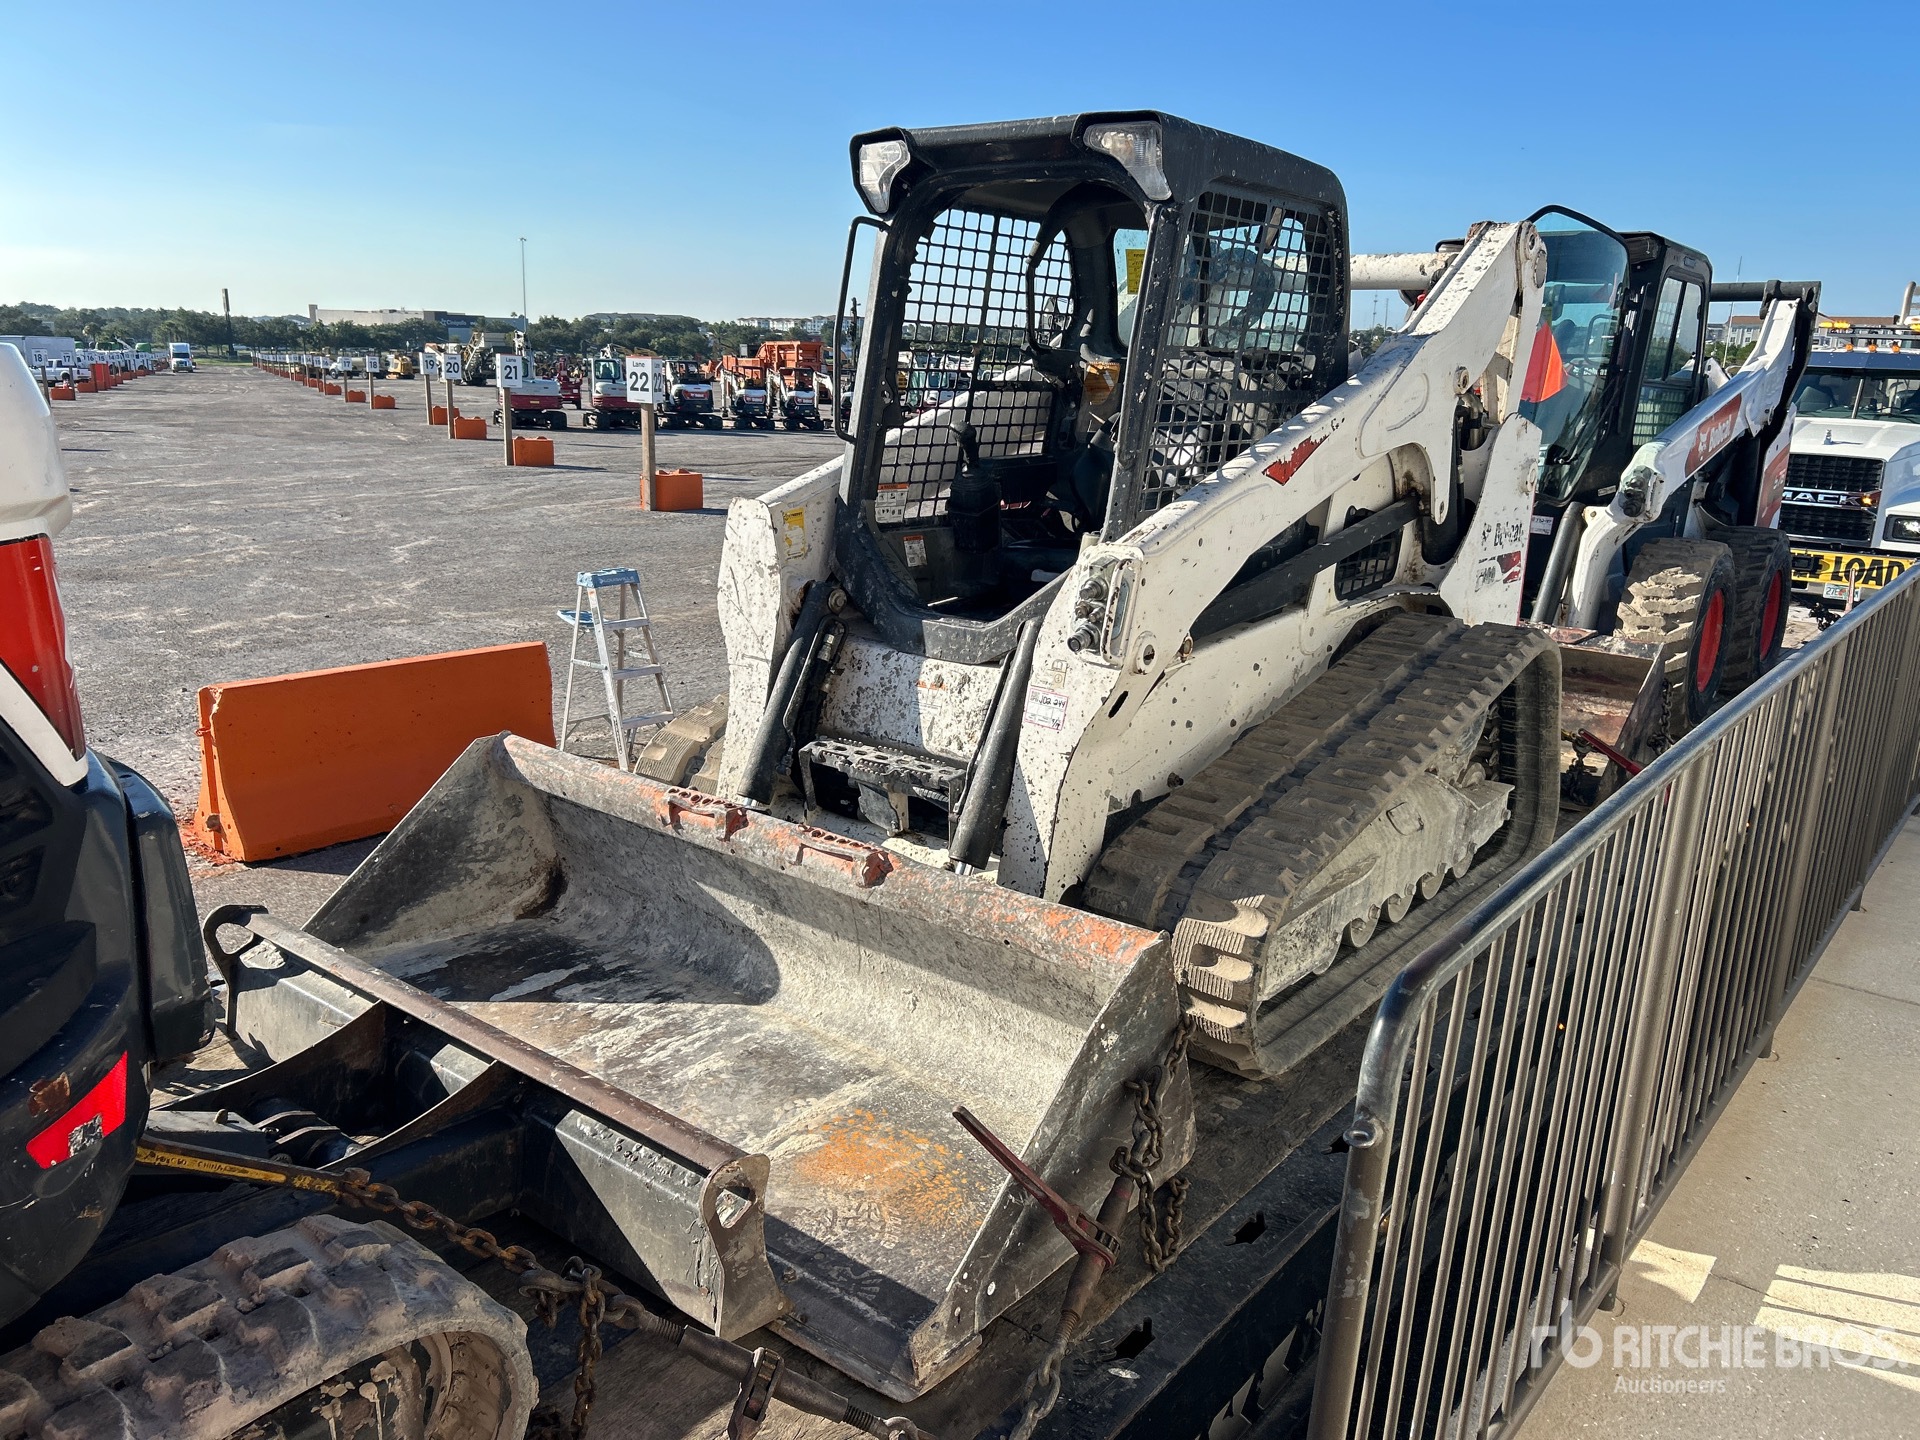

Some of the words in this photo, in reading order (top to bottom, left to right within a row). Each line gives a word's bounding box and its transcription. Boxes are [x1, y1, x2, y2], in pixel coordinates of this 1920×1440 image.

[34, 354, 42, 362] 18
[369, 361, 377, 369] 18
[425, 360, 435, 370] 19
[445, 362, 459, 373] 20
[504, 365, 517, 379] 21
[629, 371, 649, 392] 22
[653, 372, 662, 392] 22
[1709, 414, 1732, 452] Bobcat
[1831, 556, 1905, 586] LOAD
